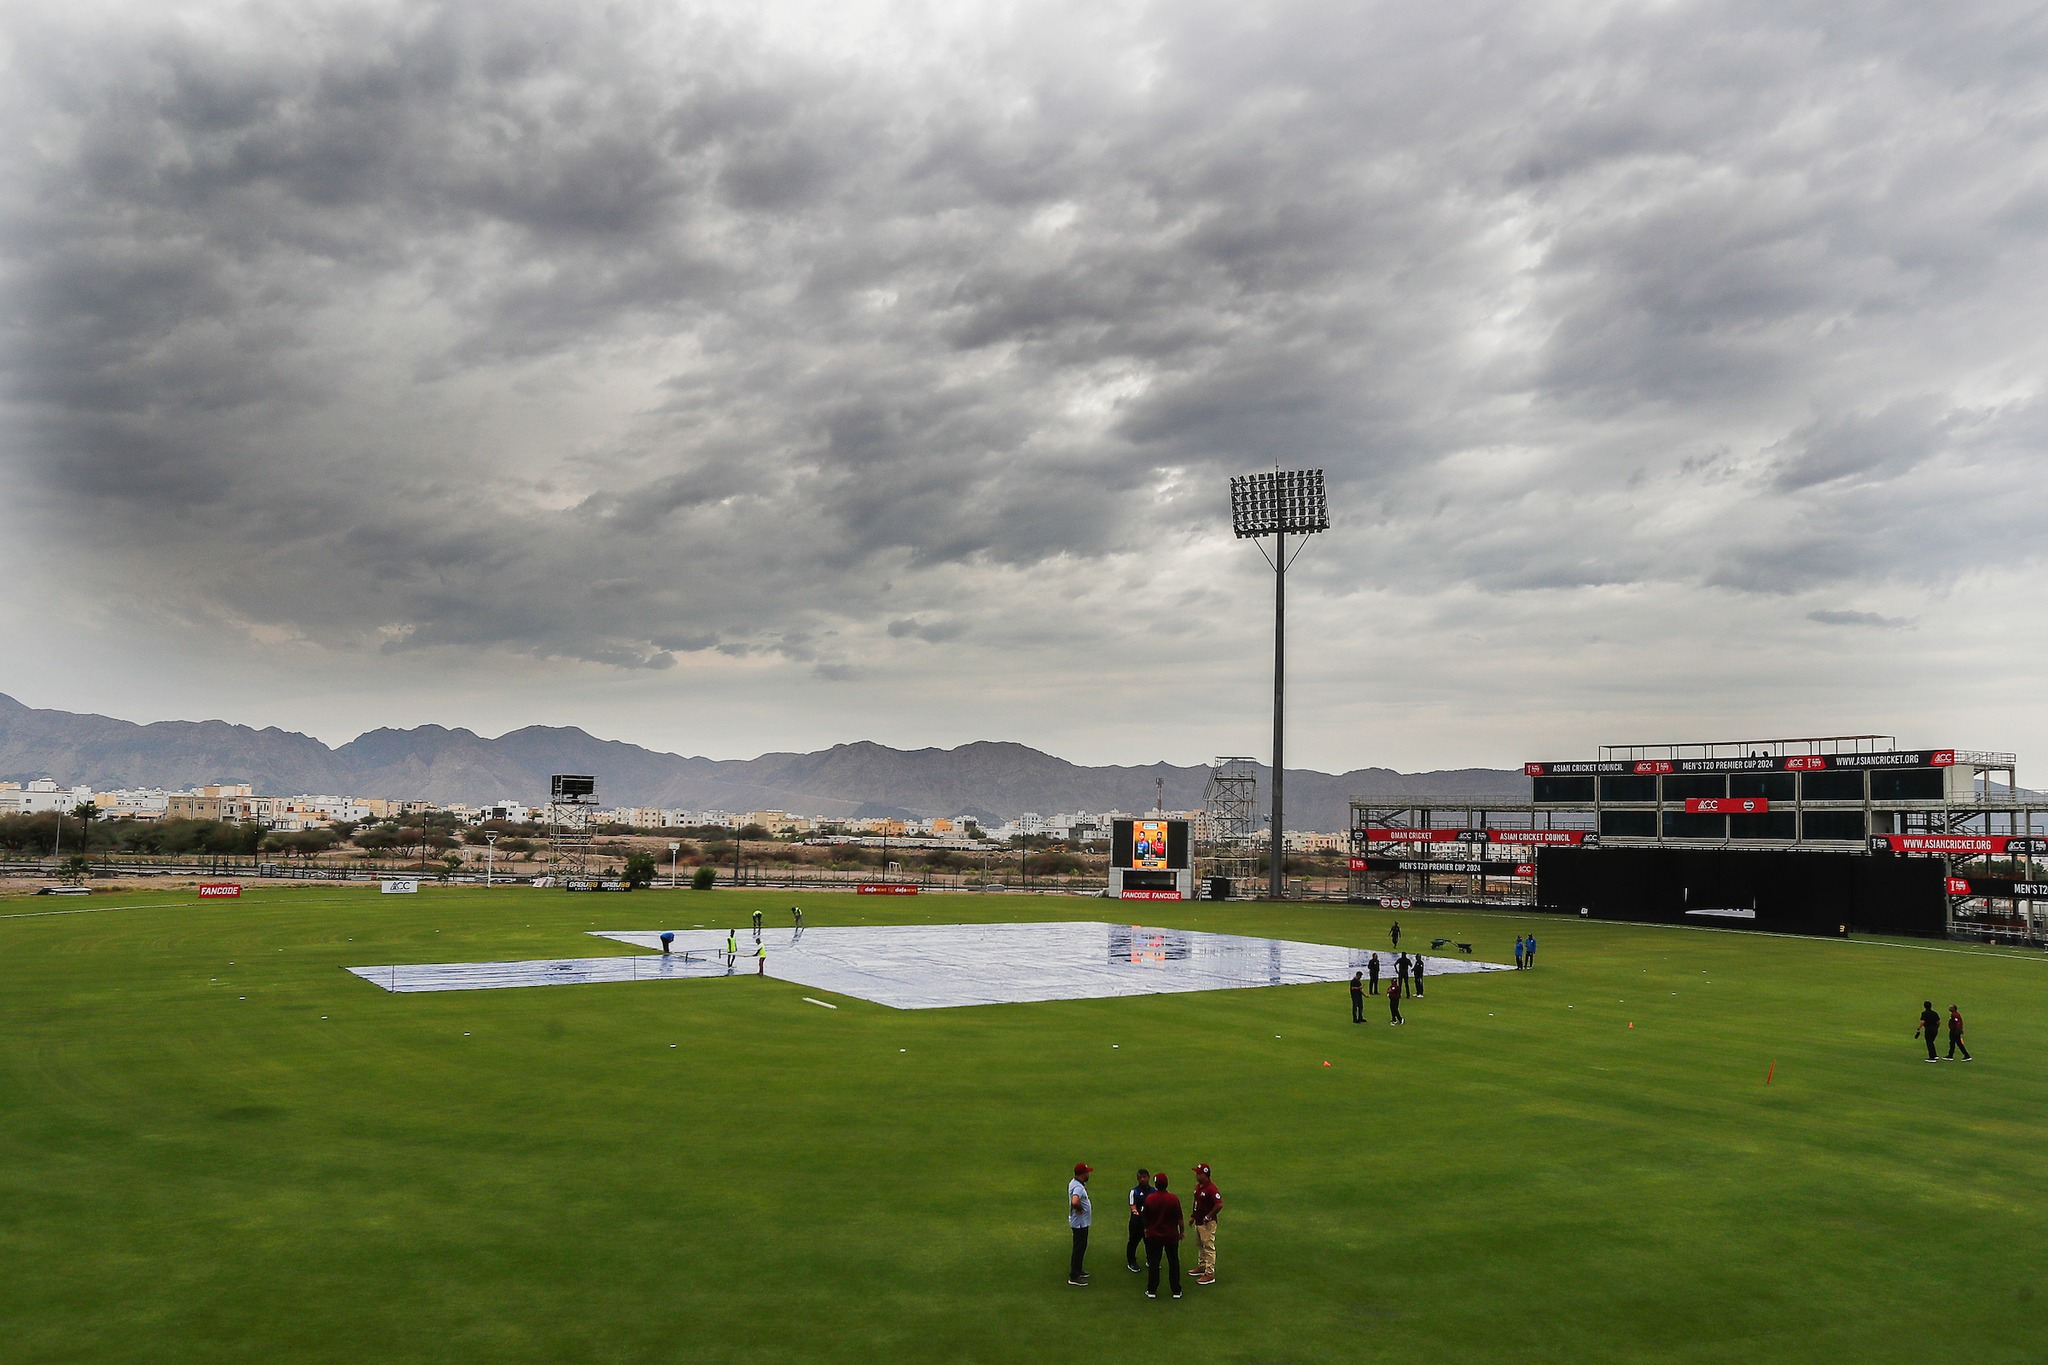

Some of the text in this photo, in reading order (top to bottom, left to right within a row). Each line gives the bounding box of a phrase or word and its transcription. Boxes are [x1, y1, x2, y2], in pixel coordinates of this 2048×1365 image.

[1683, 760, 1773, 769] MEN'S T20 PREMIER CUP 2024
[1836, 755, 1919, 766] WWW.ASIANCRICKET.ORG
[1572, 764, 1596, 772] CRICKET
[1519, 833, 1543, 841] CRICKET
[1545, 833, 1570, 841] COUNCIL
[1903, 839, 1991, 850] WWW.ASIANCRICKET.ORG
[1400, 862, 1417, 870] MEN'S
[1418, 862, 1428, 870] T20
[1429, 863, 1453, 871] PREMIER
[1455, 863, 1465, 871] CUP
[201, 887, 238, 895] FANCODE
[2015, 884, 2037, 894] MEN'S
